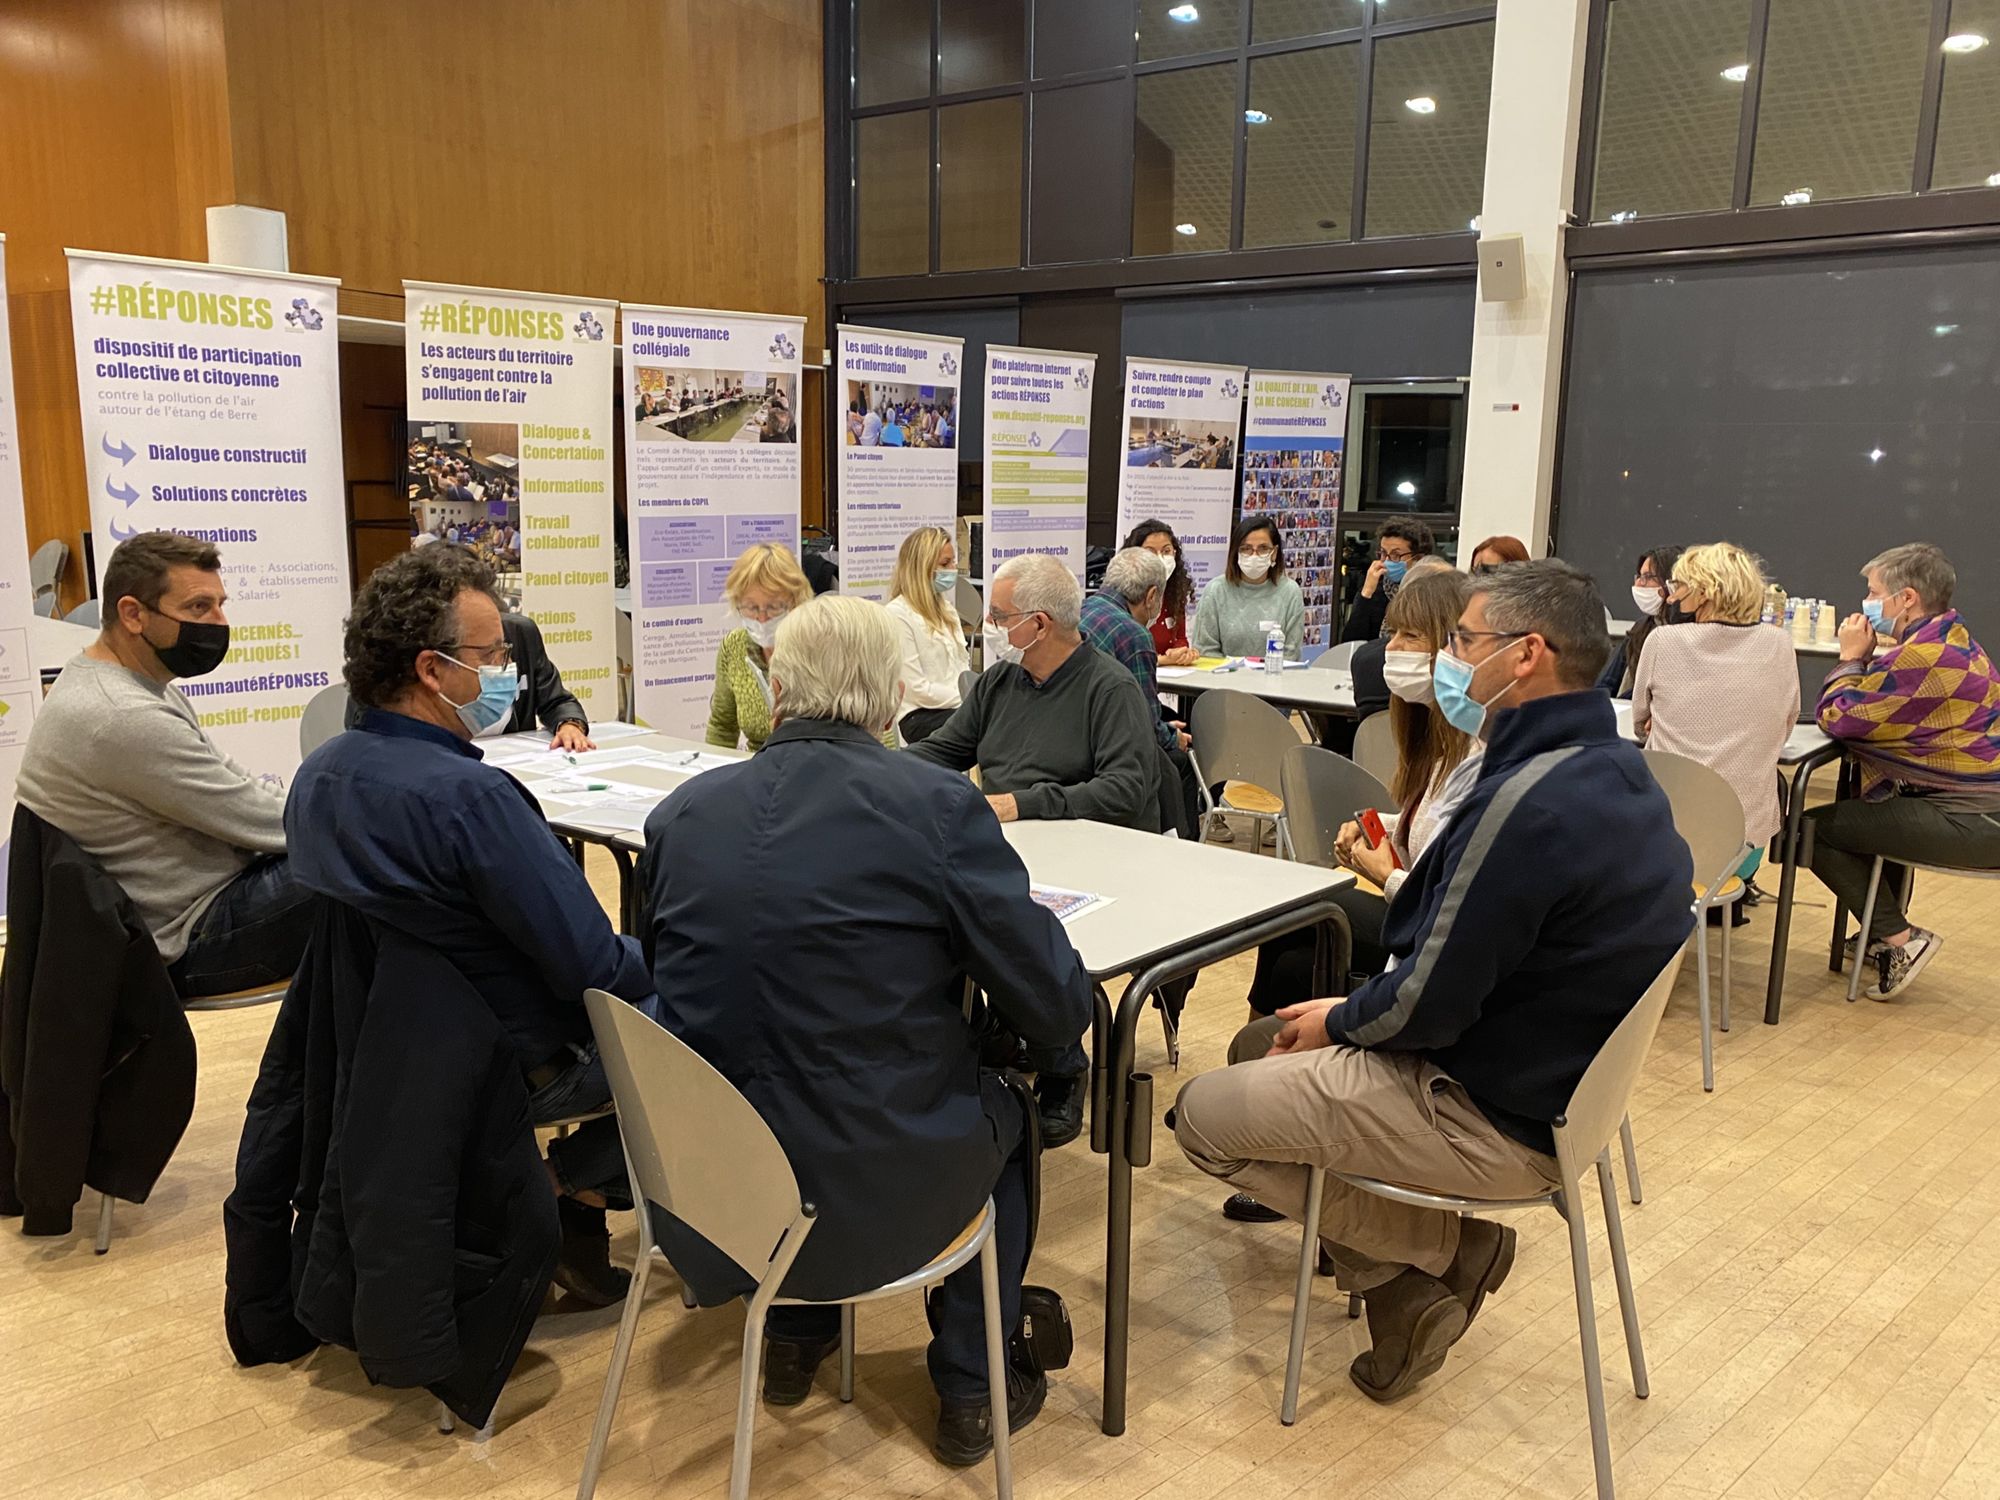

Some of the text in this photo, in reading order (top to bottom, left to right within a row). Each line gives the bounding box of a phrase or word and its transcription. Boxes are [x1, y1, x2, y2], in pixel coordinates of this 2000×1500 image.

[90, 281, 274, 330] #RÉPONSES
[420, 300, 564, 341] #RÉPONSES
[632, 322, 730, 341] Une gouvernance
[94, 337, 302, 368] dispositif de participation
[421, 343, 573, 365] Les acteurs du territoire
[632, 342, 690, 357] collégiale
[845, 340, 927, 360] Les outils de dialogue
[846, 359, 854, 369] et
[992, 359, 1071, 375] Une plateforme internet
[96, 362, 280, 388] collective et citoyenne
[421, 365, 552, 384] s'engagent contre la
[992, 375, 1064, 389] pour suivre toutes les
[1132, 370, 1211, 385] Suivre, rendre compte
[422, 386, 527, 403] pollution de l'air
[1132, 385, 1203, 398] et compléter le plan
[1255, 382, 1263, 392] LA
[1292, 383, 1300, 393] DE
[98, 390, 256, 406] contre la pollution de l'air
[992, 390, 1050, 403] actions RÉPONSES
[99, 406, 141, 416] autour
[146, 406, 160, 417] de
[210, 408, 224, 419] de
[227, 409, 258, 421] Berre
[522, 424, 591, 441] Dialogue &
[148, 444, 307, 464] Dialogue constructif
[523, 444, 605, 460] Concertation
[523, 478, 605, 494] Informations
[152, 485, 307, 505] Solutions concrètes
[651, 498, 681, 506] membres
[683, 498, 691, 506] du
[525, 515, 570, 530] Travail
[526, 535, 600, 550] collaboratif
[992, 548, 1002, 558] Un
[220, 564, 256, 574] partite
[268, 562, 338, 572] Associations,
[260, 575, 339, 586] établissements
[525, 571, 609, 586] Panel citoyen
[230, 621, 303, 641] NCERNÉS...
[643, 620, 650, 628] Le
[652, 619, 673, 627] comité
[544, 628, 592, 644] ncrètes
[223, 644, 291, 664] MPLIQUÉS
[560, 667, 610, 682] ernance
[645, 673, 715, 687] Un financement partag
[179, 672, 329, 697] mmunautéRÉPONSES
